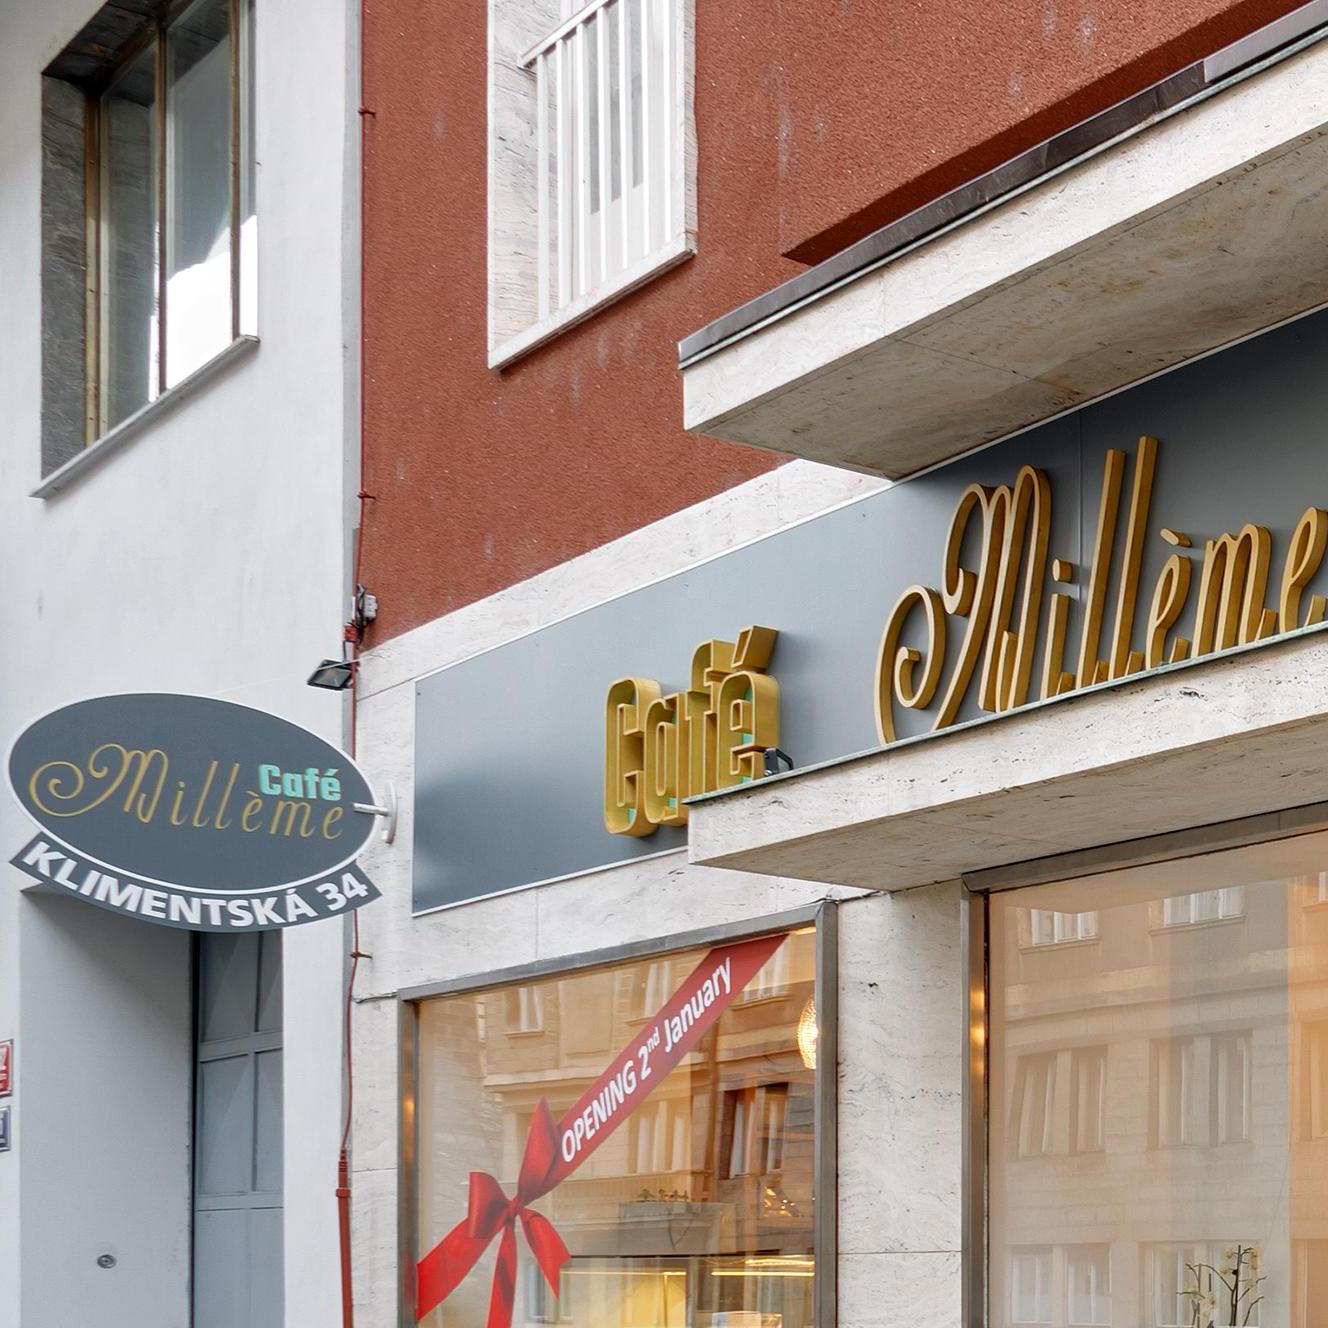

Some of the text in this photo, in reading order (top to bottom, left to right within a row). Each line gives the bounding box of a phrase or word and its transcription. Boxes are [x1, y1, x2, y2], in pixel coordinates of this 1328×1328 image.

[604, 626, 780, 838] Café
[28, 743, 345, 840] Millème
[258, 763, 342, 802] Café
[22, 840, 369, 928] KLIMENTSKÁ 34
[561, 957, 731, 1163] OPENING 2nd January
